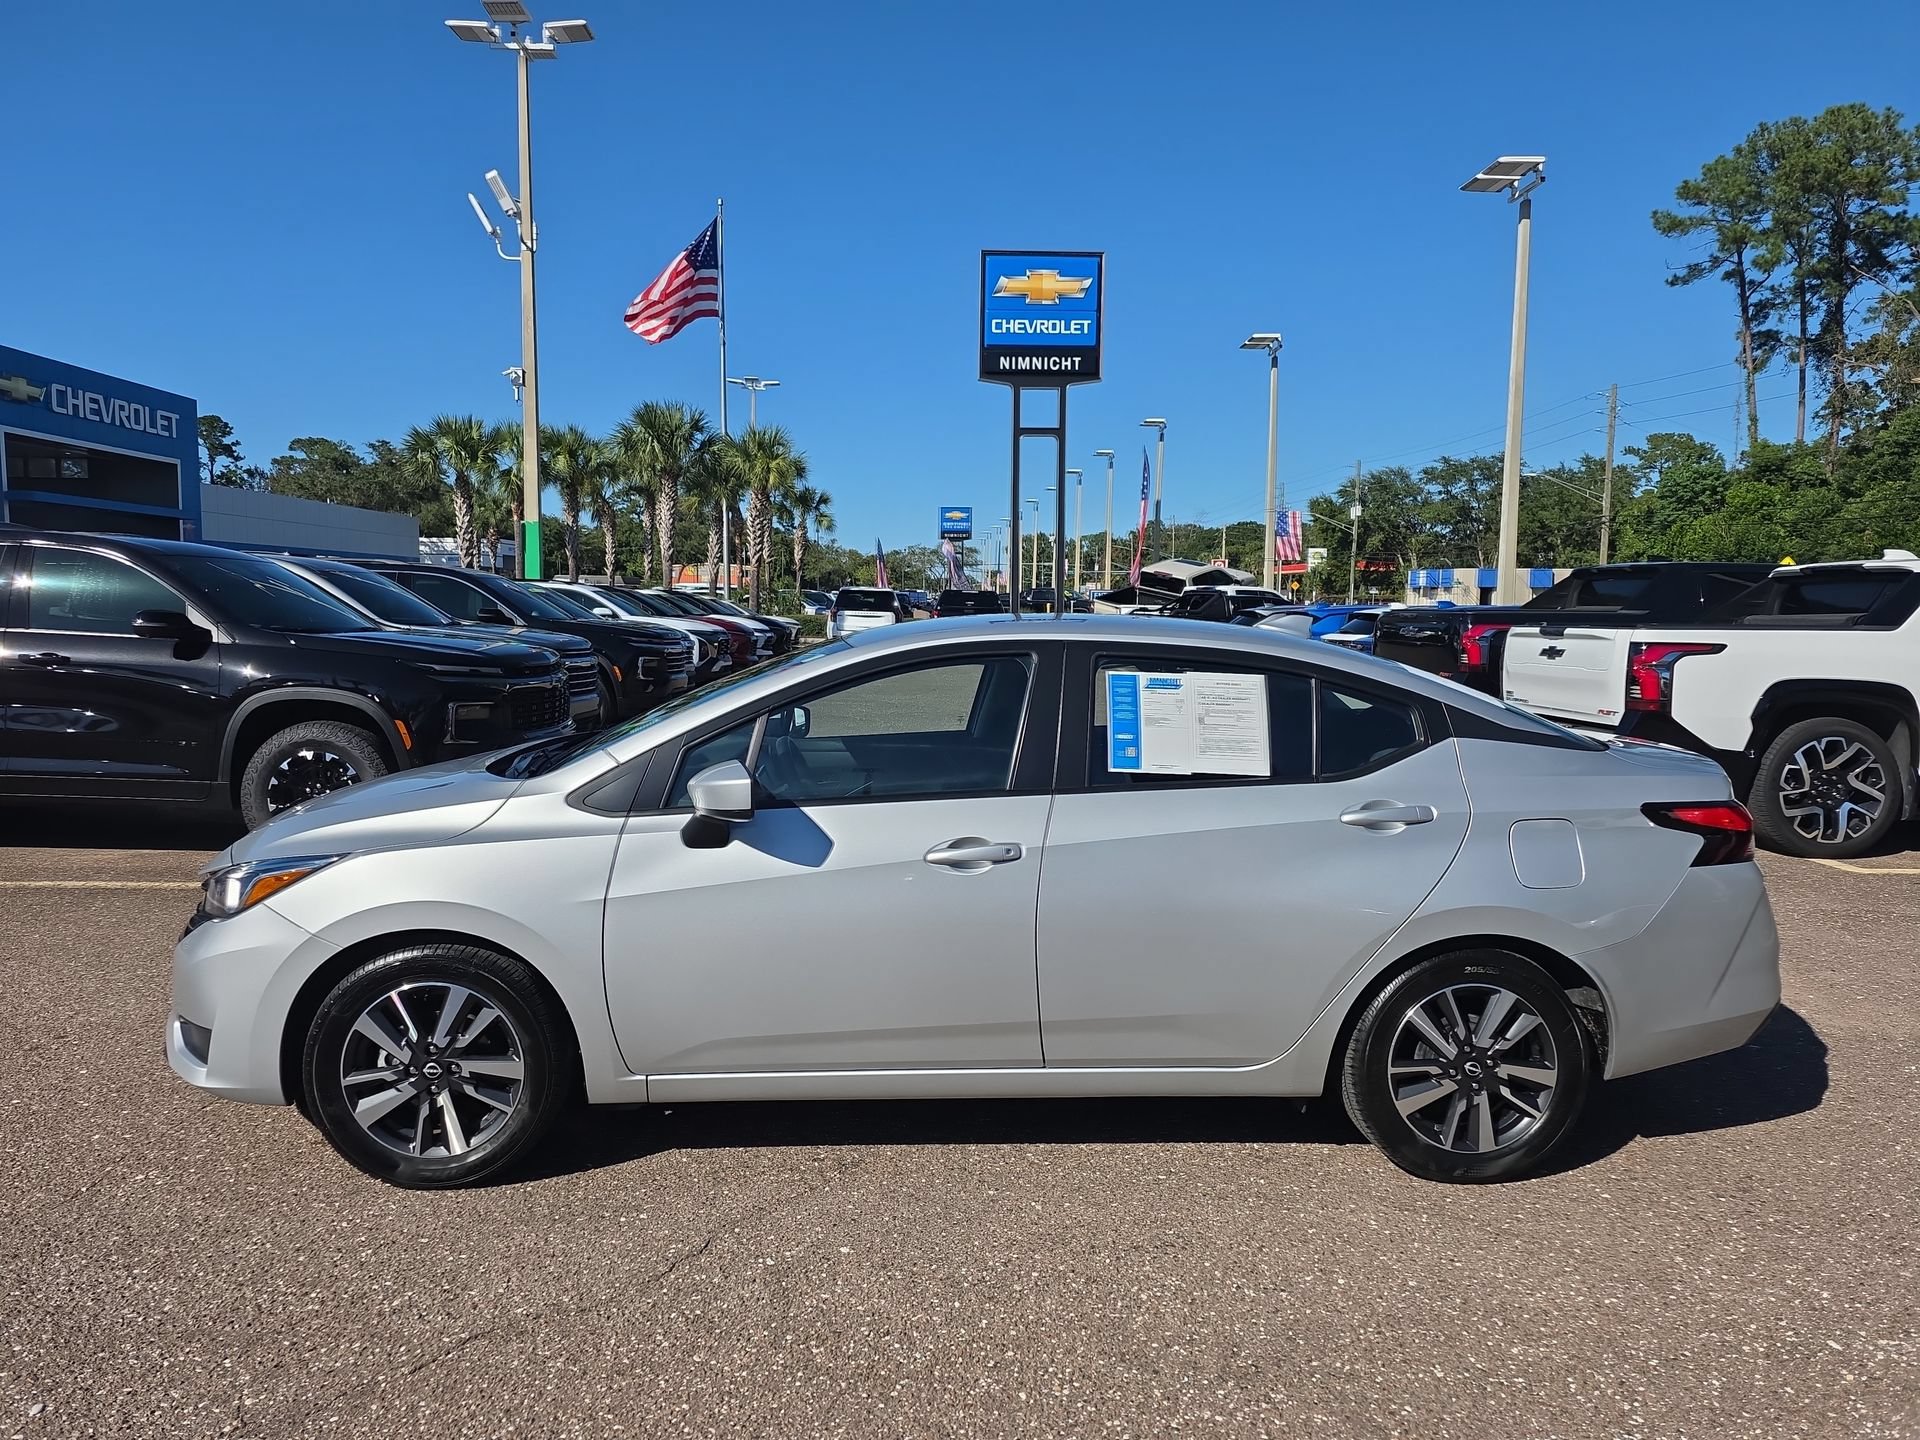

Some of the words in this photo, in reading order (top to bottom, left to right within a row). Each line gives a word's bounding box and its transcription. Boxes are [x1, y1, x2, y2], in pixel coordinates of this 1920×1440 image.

[991, 319, 1091, 334] CHEVROLET
[1000, 356, 1081, 370] NIMNICHT
[51, 383, 180, 438] CHEVROLET
